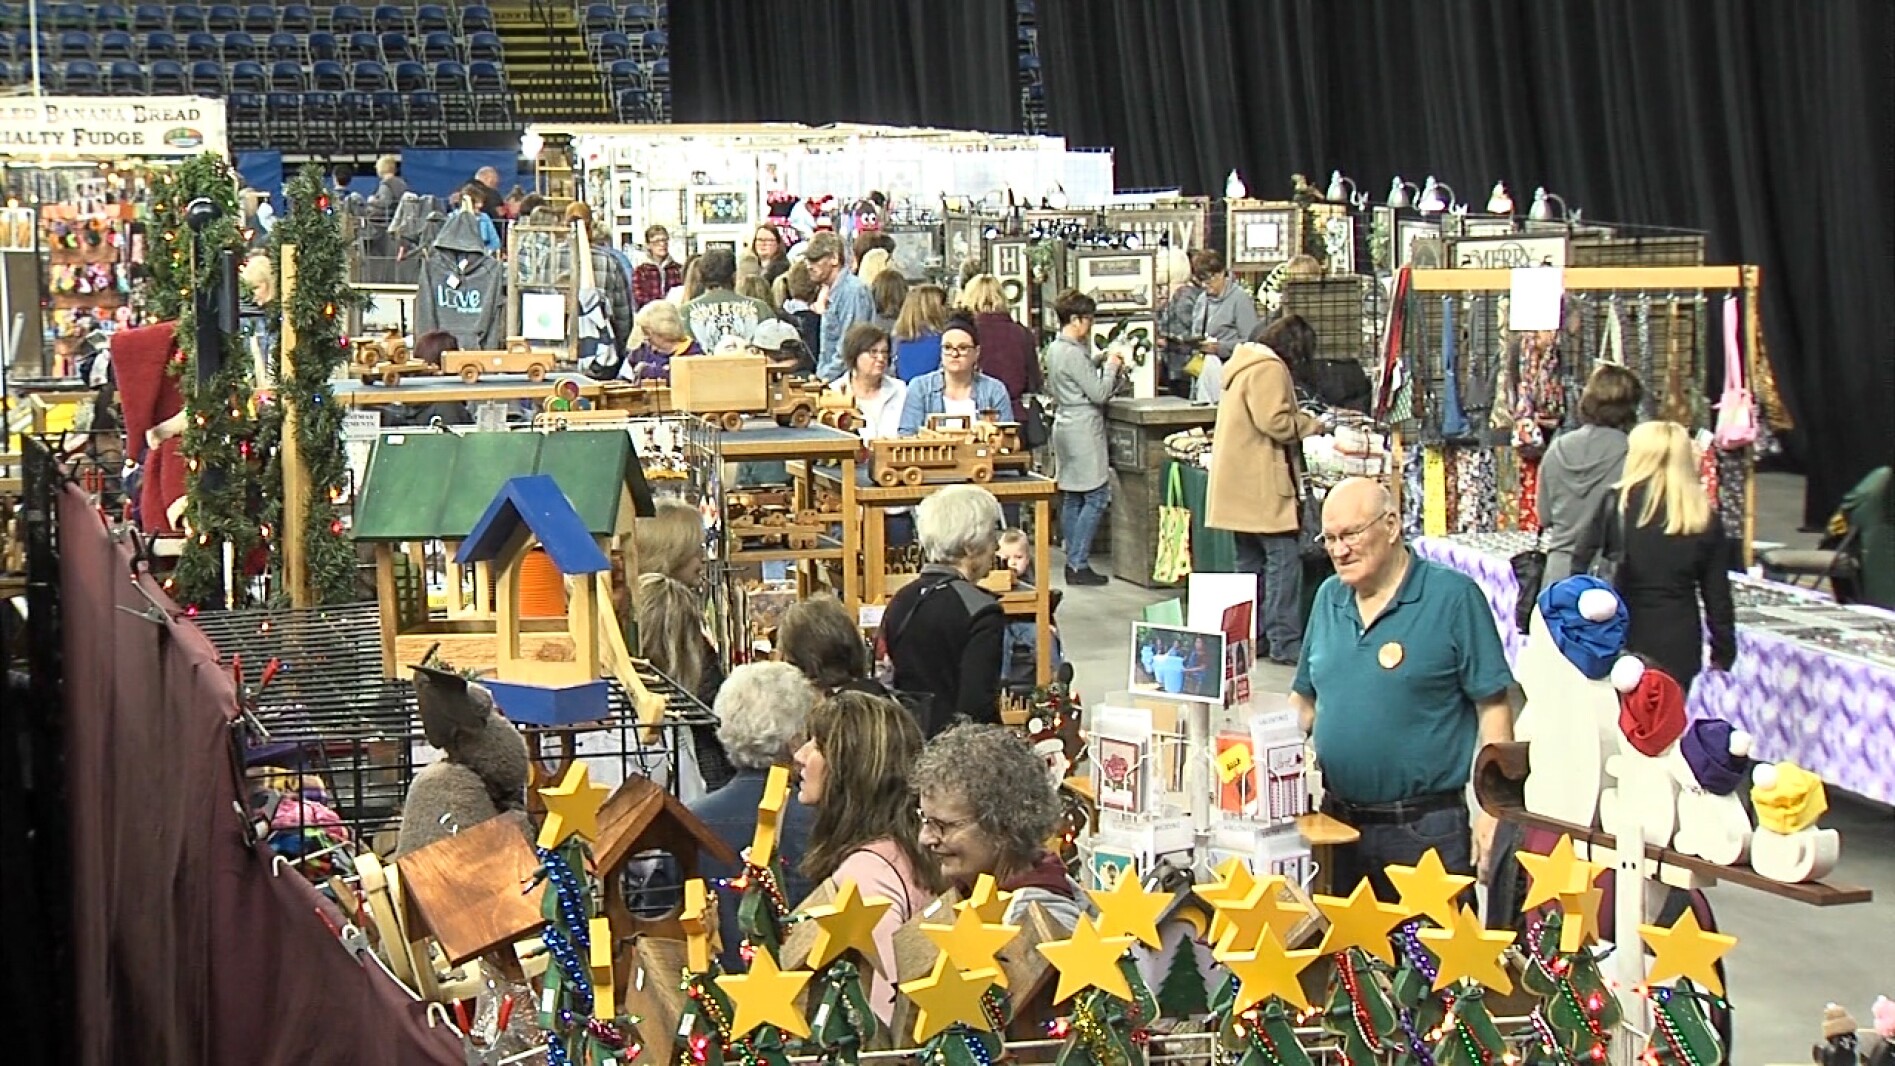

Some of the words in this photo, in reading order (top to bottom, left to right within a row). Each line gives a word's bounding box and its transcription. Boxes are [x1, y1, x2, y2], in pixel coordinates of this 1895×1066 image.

[45, 104, 126, 123] BANANA
[133, 104, 201, 123] BREAD
[73, 128, 145, 147] FUDGE
